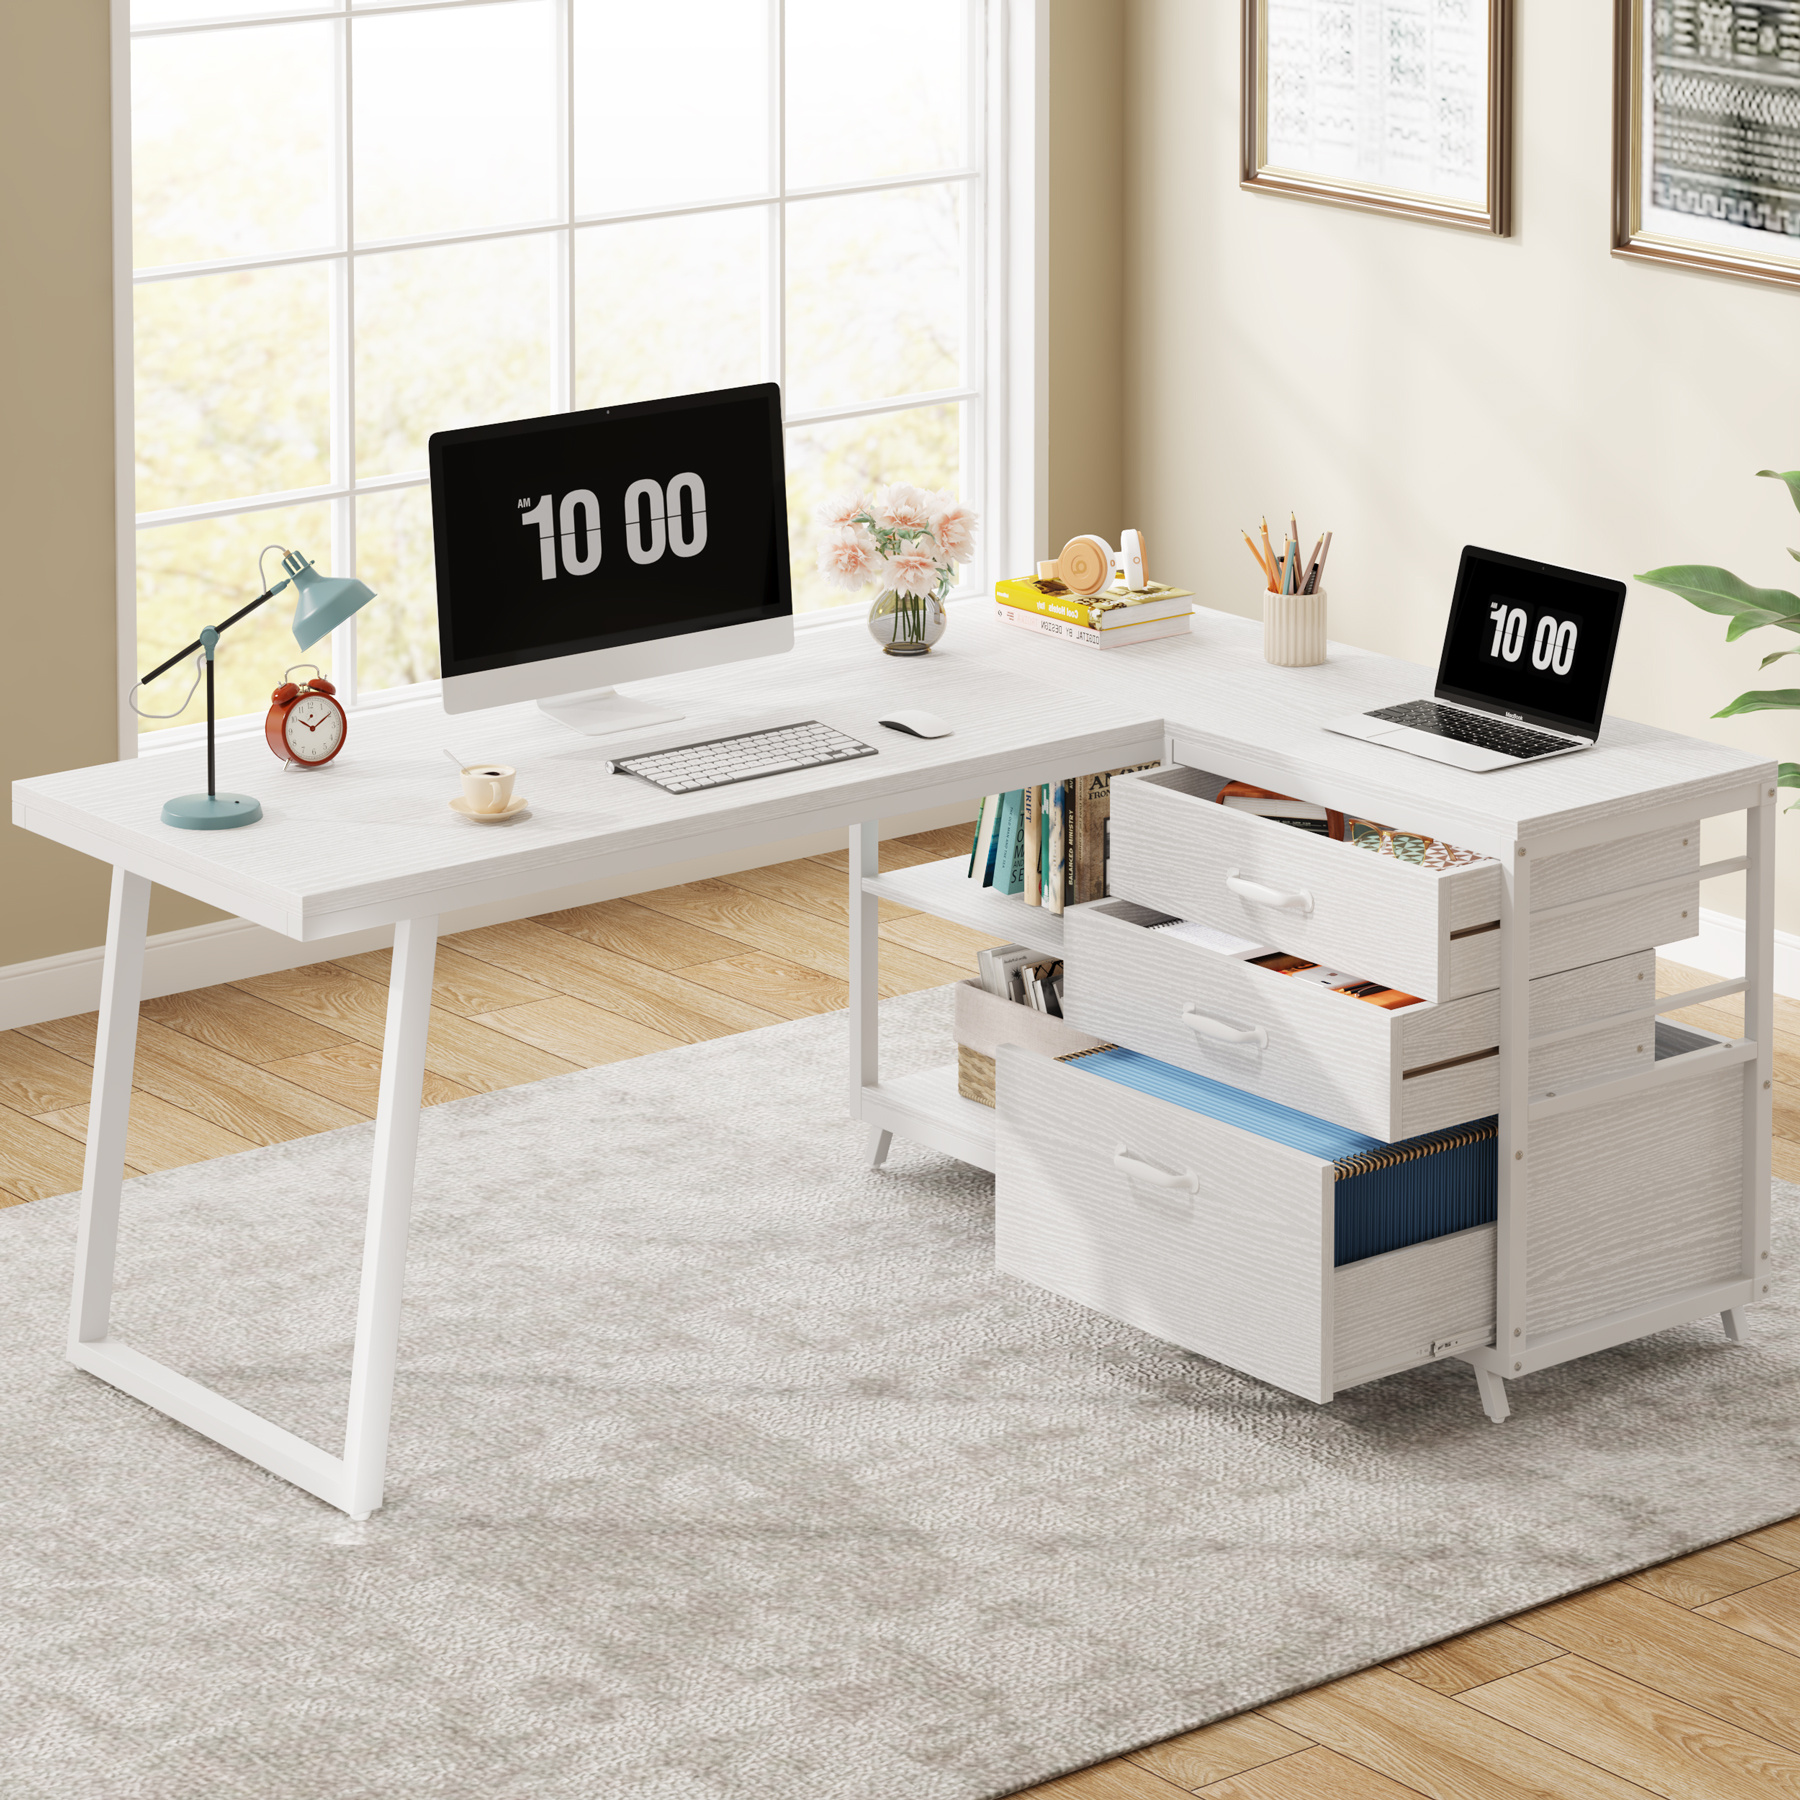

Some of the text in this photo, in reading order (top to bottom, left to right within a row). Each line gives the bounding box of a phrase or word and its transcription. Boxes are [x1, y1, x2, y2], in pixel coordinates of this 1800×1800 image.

[517, 497, 531, 509] AM
[521, 471, 708, 581] 10 00
[1490, 604, 1578, 676] 10 00
